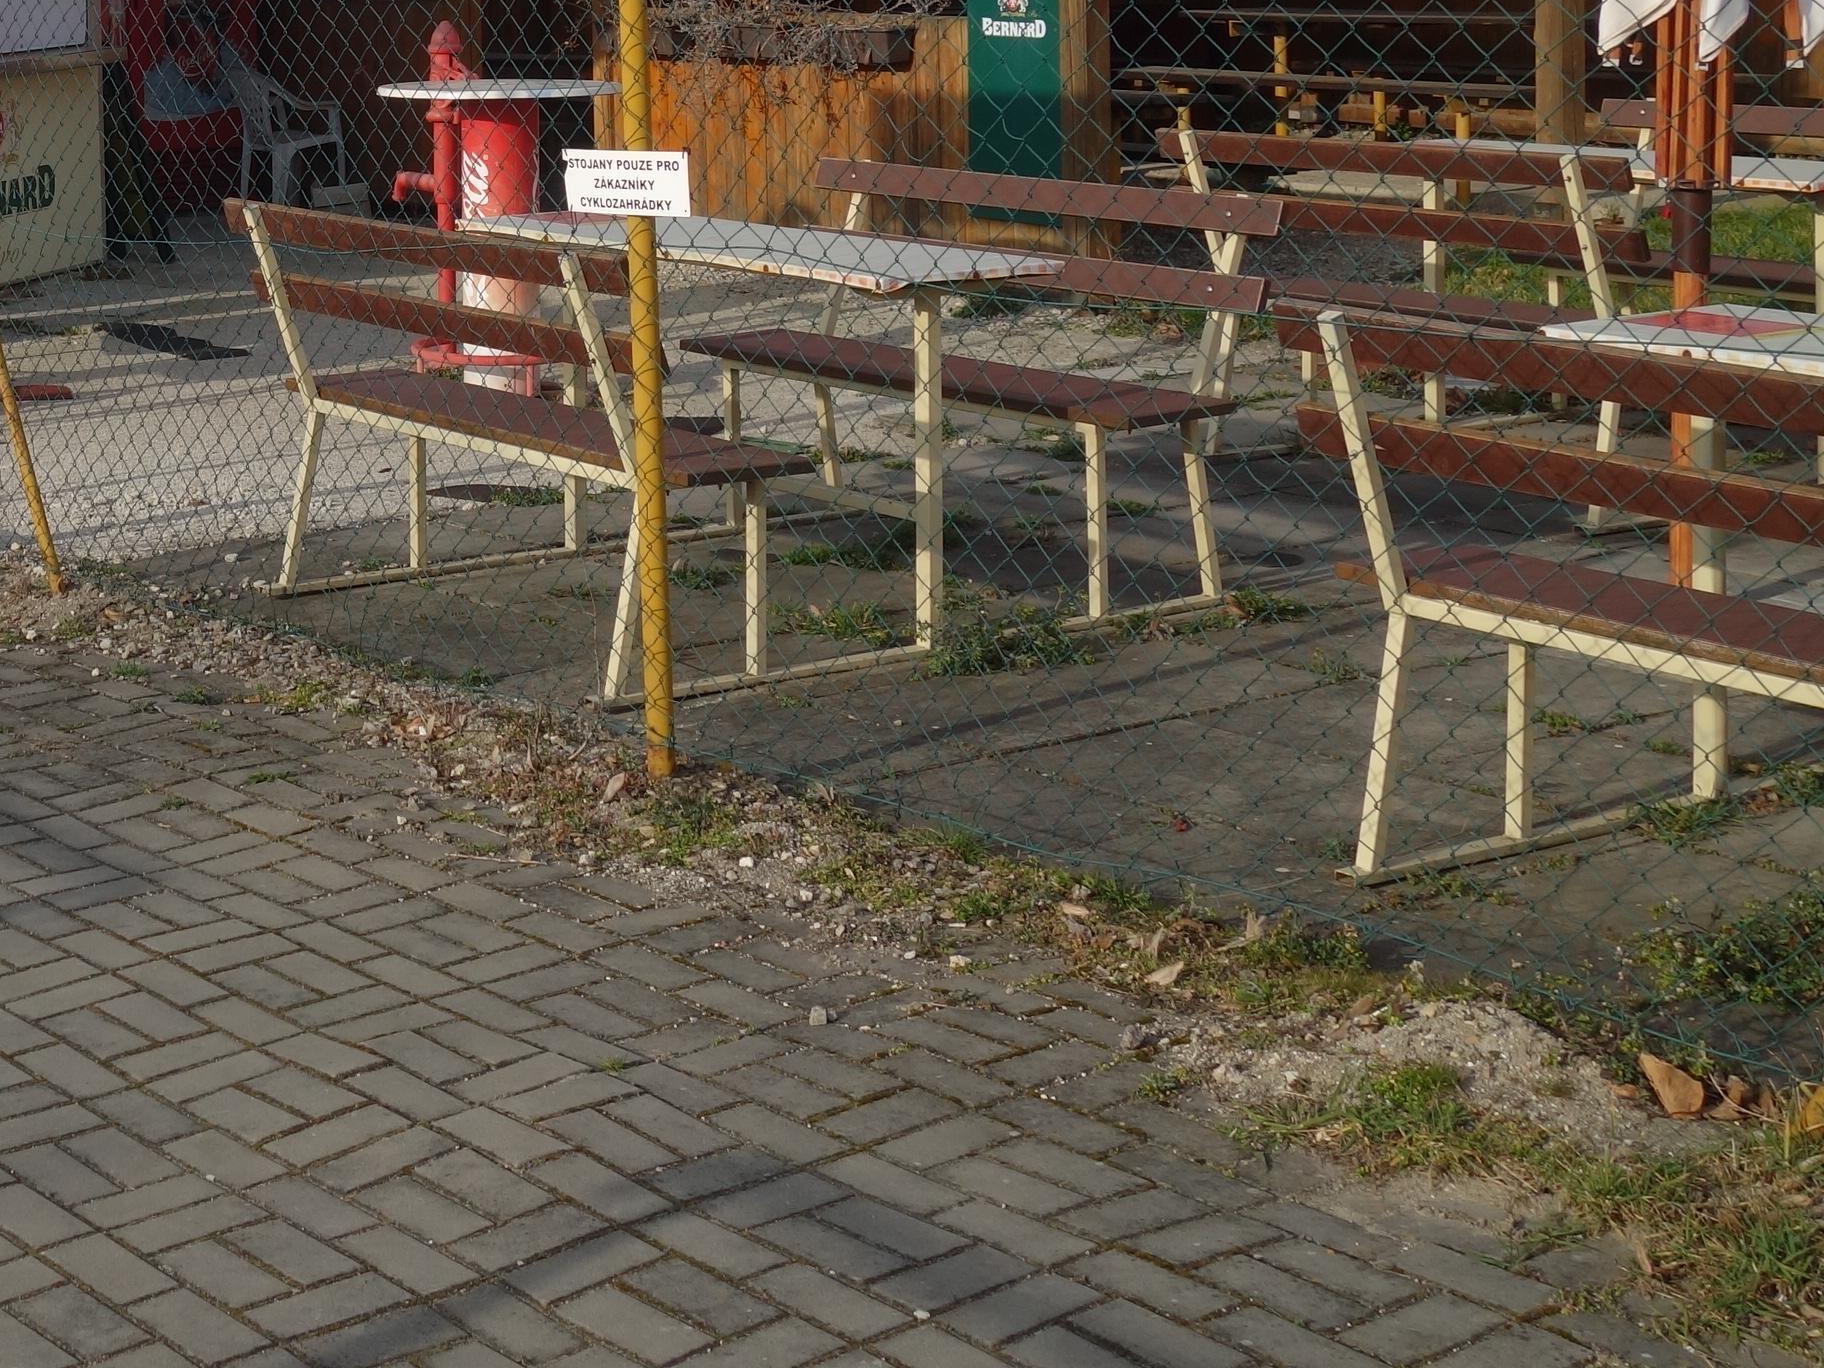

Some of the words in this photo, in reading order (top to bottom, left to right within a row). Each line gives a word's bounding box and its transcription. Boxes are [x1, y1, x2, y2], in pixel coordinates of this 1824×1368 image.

[981, 17, 1047, 39] BERNARD
[568, 158, 613, 170] STOJANY
[616, 159, 653, 171] POUZE
[656, 160, 680, 171] PRO
[594, 176, 655, 191] ZÁKAZNÍKY
[580, 195, 672, 211] CYKLOZAHRÁDKY
